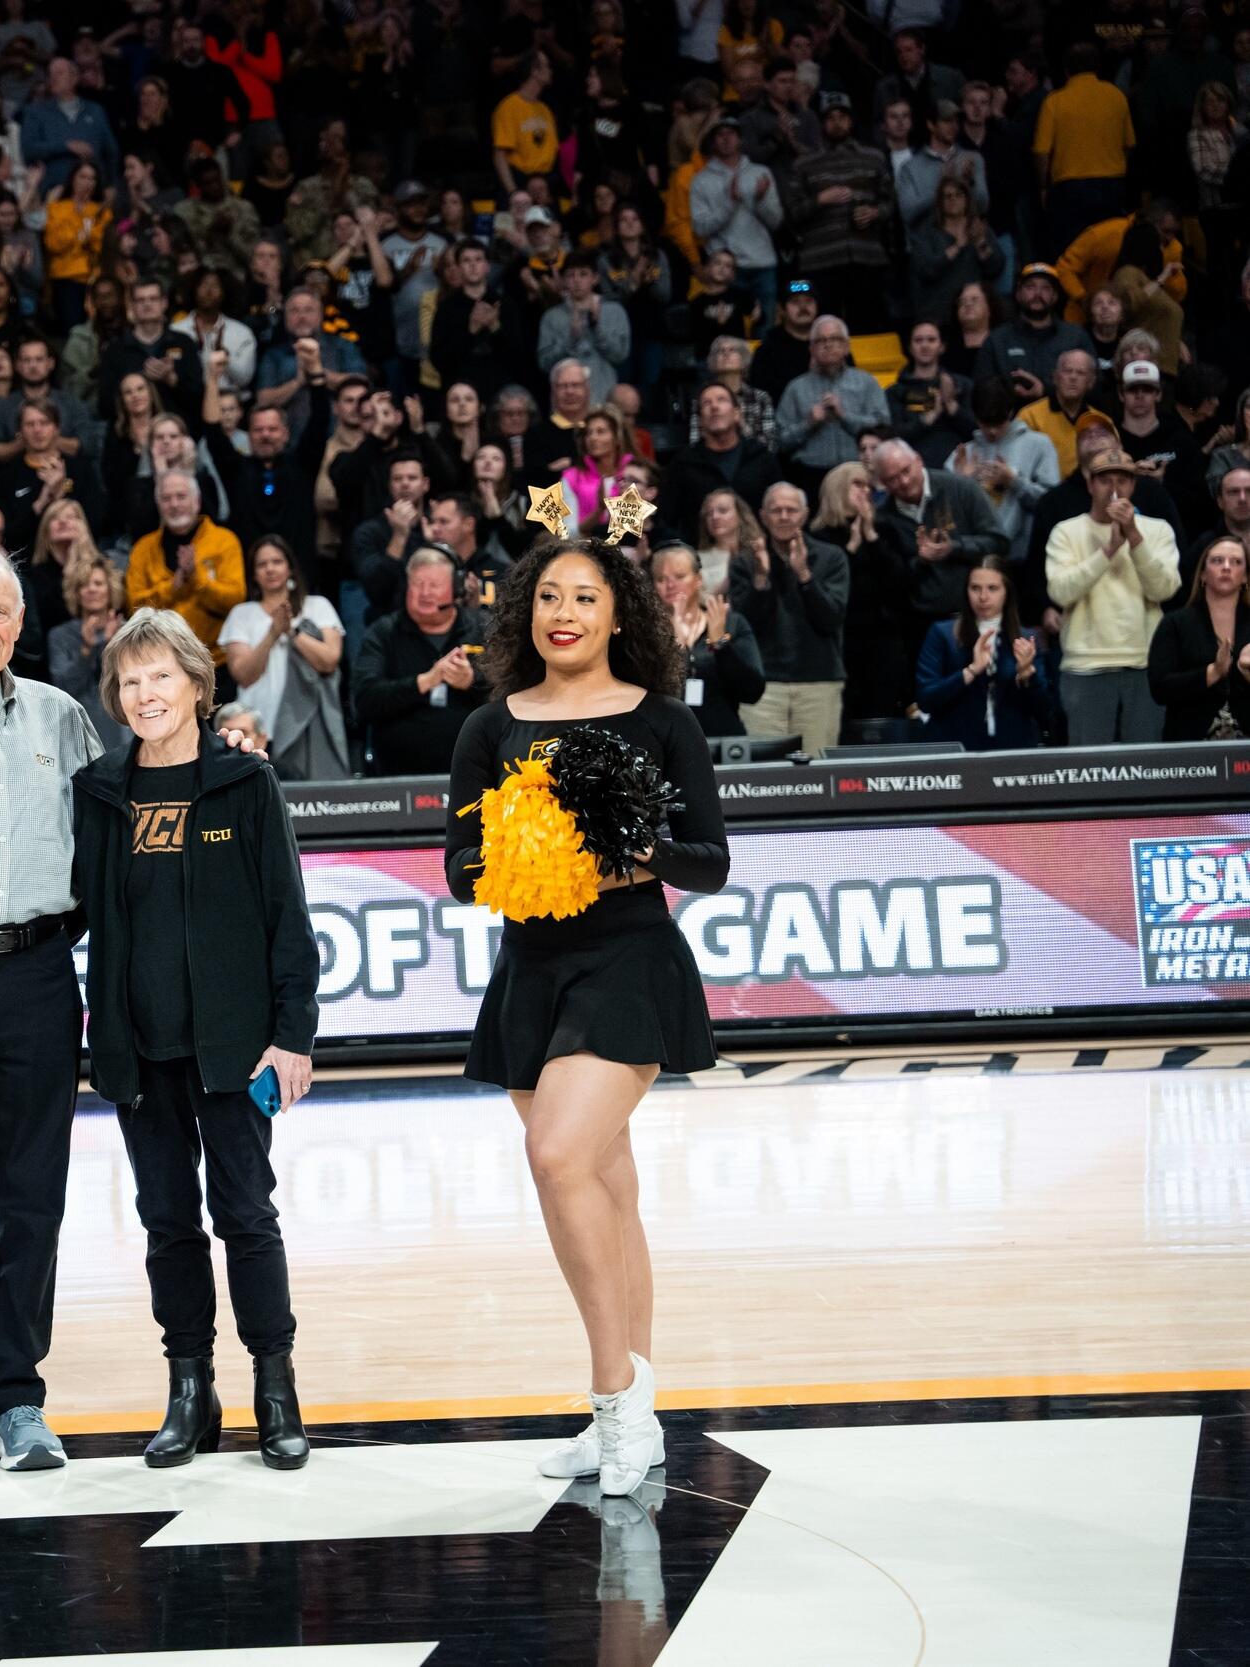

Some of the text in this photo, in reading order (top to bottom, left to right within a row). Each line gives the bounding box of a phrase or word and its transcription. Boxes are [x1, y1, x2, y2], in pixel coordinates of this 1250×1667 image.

[535, 492, 554, 513] HAPPY
[544, 500, 557, 515] NEW
[616, 501, 642, 511] HAPPY
[546, 505, 562, 522] YEAR
[617, 516, 636, 525] YEAR
[620, 509, 638, 518] NEW
[39, 755, 55, 767] VCU
[201, 828, 234, 843] VCU
[1151, 854, 1250, 905] USA
[678, 881, 1001, 980] GAME
[1148, 925, 1234, 955] IRON
[1155, 951, 1250, 981] META
